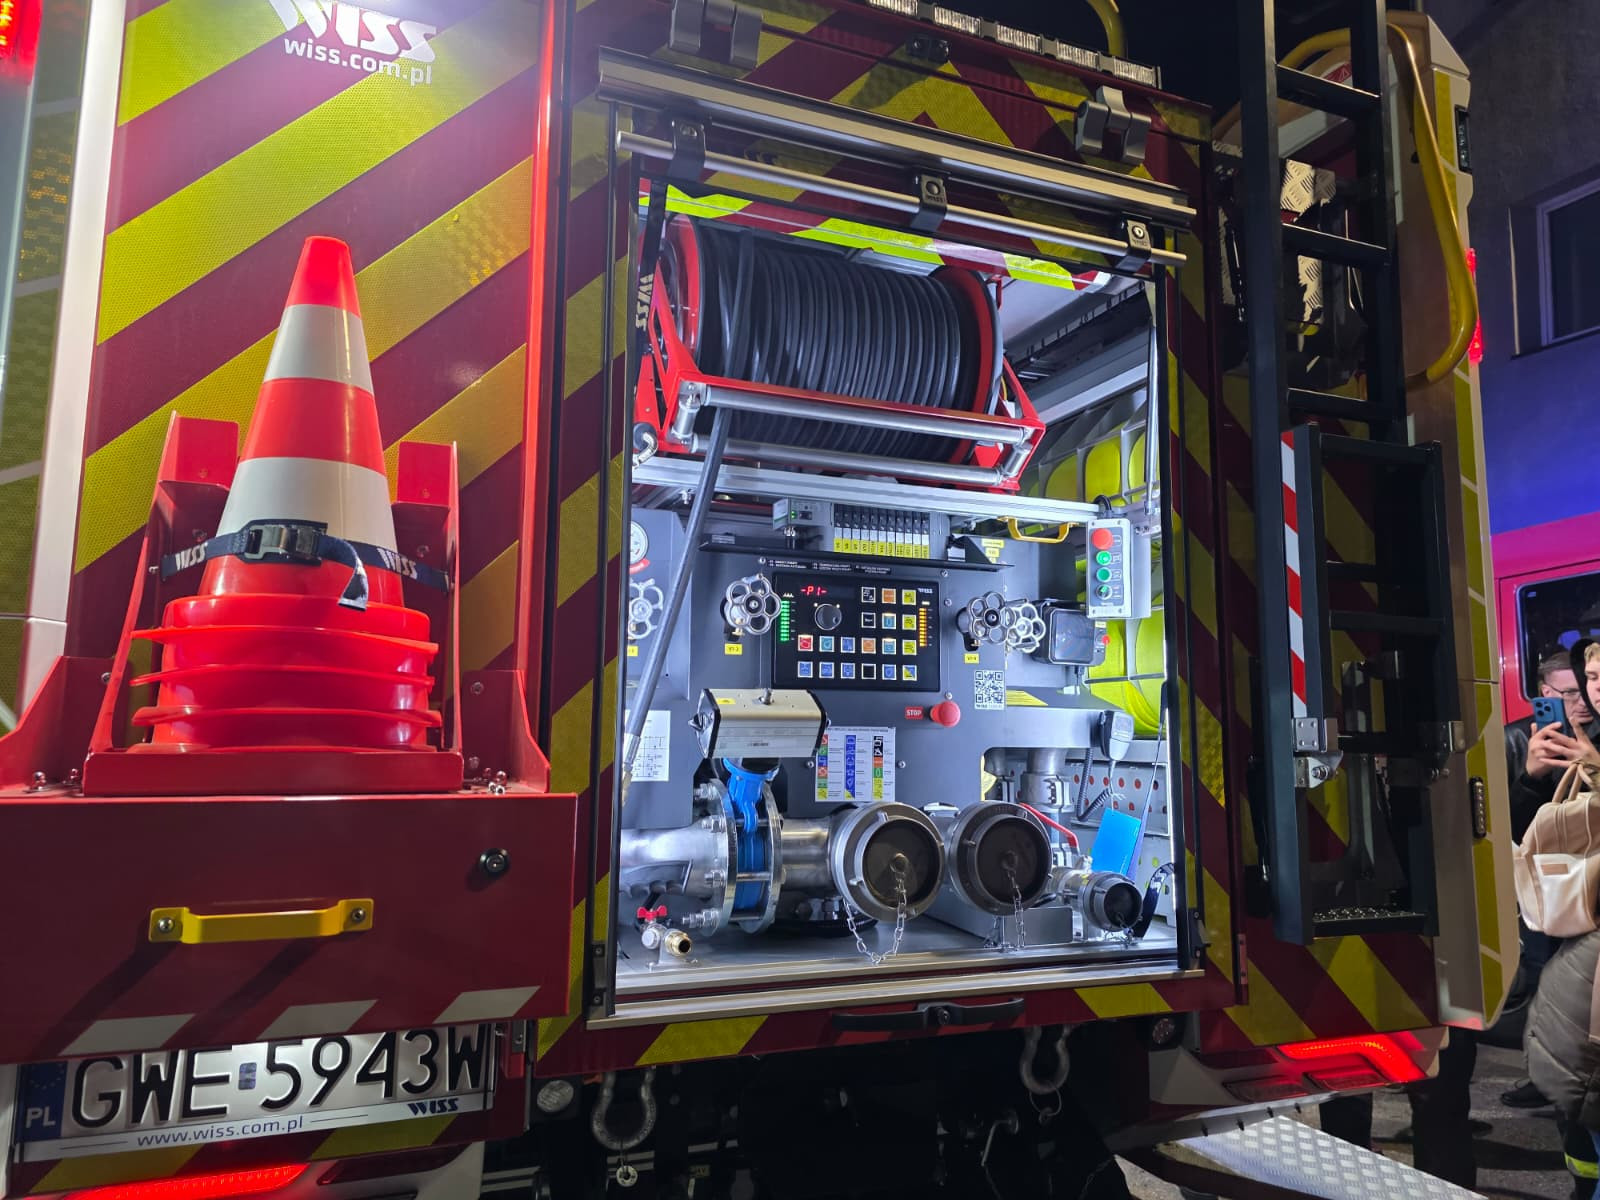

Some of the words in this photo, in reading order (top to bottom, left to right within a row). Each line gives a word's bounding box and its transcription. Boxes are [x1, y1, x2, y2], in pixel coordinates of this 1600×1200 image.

[283, 37, 432, 87] wiss.com.pl
[175, 542, 209, 572] WISS
[377, 547, 419, 580] WISS
[906, 708, 922, 717] STOP
[72, 1047, 233, 1129] GWE
[260, 1024, 485, 1109] 5943W
[25, 1106, 56, 1129] PL
[407, 1097, 459, 1117] WISS
[136, 1115, 303, 1147] www.wiss.com.pl
